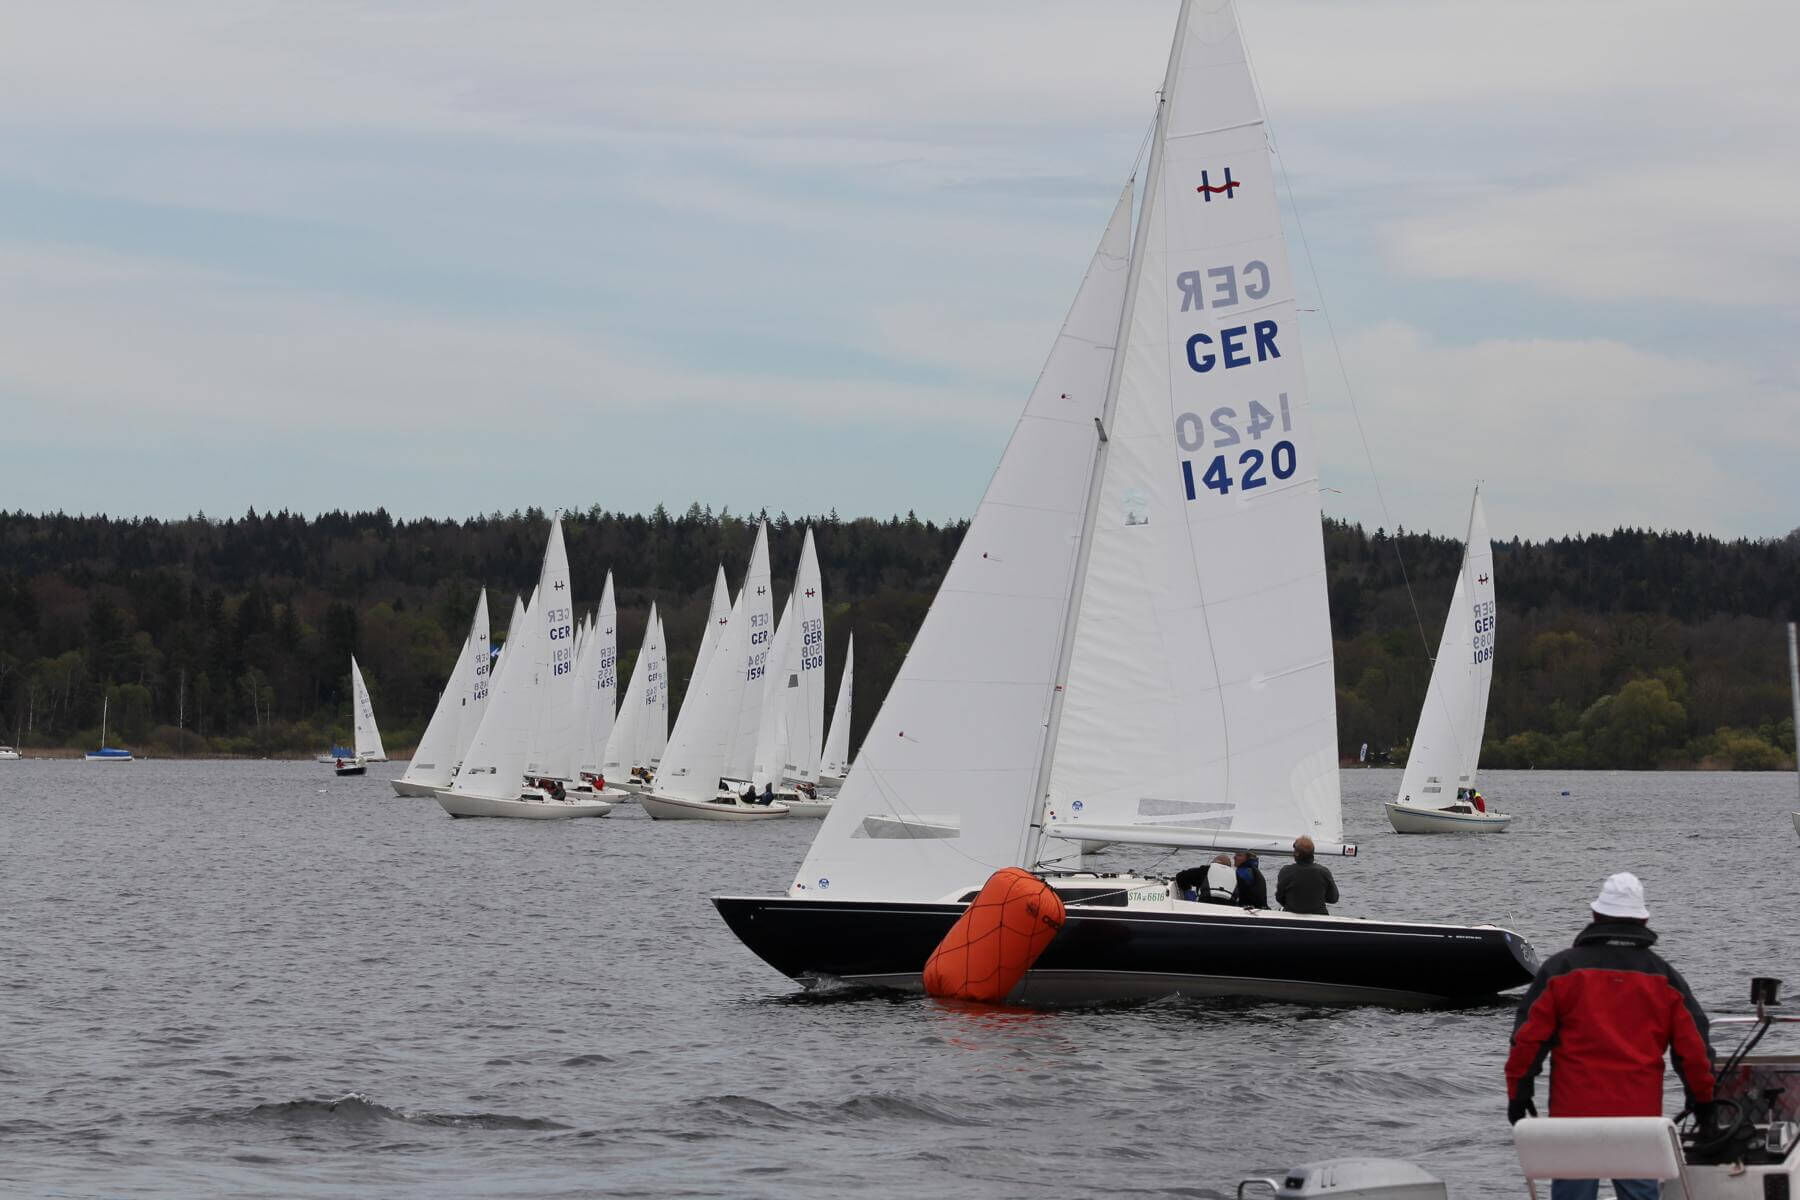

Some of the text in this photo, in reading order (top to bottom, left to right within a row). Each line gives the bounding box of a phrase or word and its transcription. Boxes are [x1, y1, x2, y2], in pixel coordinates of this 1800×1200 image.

[1185, 319, 1281, 374] GER
[1181, 440, 1297, 501] 1420
[1474, 615, 1495, 634] GER
[550, 625, 570, 641] GER
[751, 630, 768, 645] GER
[803, 630, 822, 646] GER
[601, 656, 615, 669] GER
[801, 655, 823, 671] 1508
[1473, 646, 1493, 665] 1089
[476, 664, 489, 676] GER
[553, 660, 571, 676] 1691
[746, 664, 765, 681] 1594
[597, 676, 614, 690] 1455
[1128, 892, 1142, 901] STA
